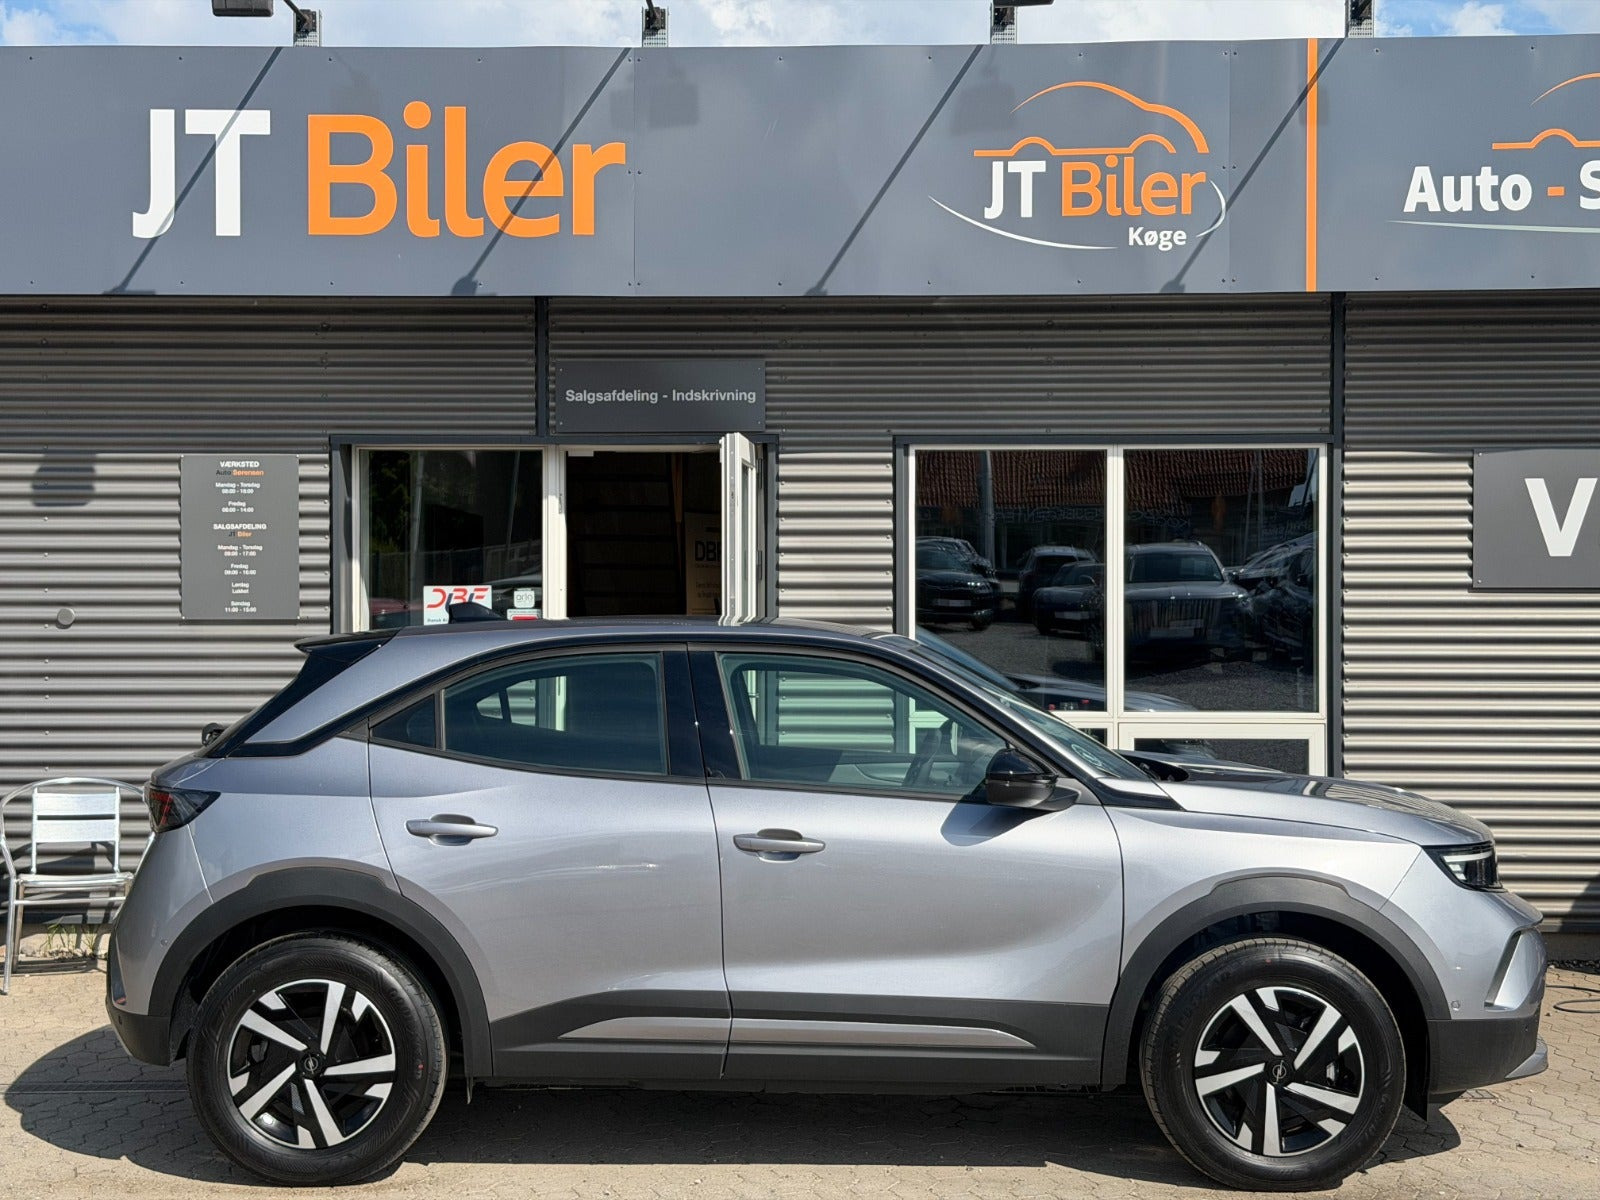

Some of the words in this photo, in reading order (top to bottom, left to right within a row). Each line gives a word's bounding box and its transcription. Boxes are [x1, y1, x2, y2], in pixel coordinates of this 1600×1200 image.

[132, 108, 271, 238] JT
[307, 100, 627, 237] Biler
[983, 160, 1047, 219] JT
[1061, 155, 1206, 217] Biler
[1403, 165, 1533, 213] Auto
[1127, 225, 1187, 251] Køge
[565, 389, 658, 404] Salgsafdeling
[672, 388, 756, 404] Indskrivning
[219, 460, 260, 468] VÆRKSTED
